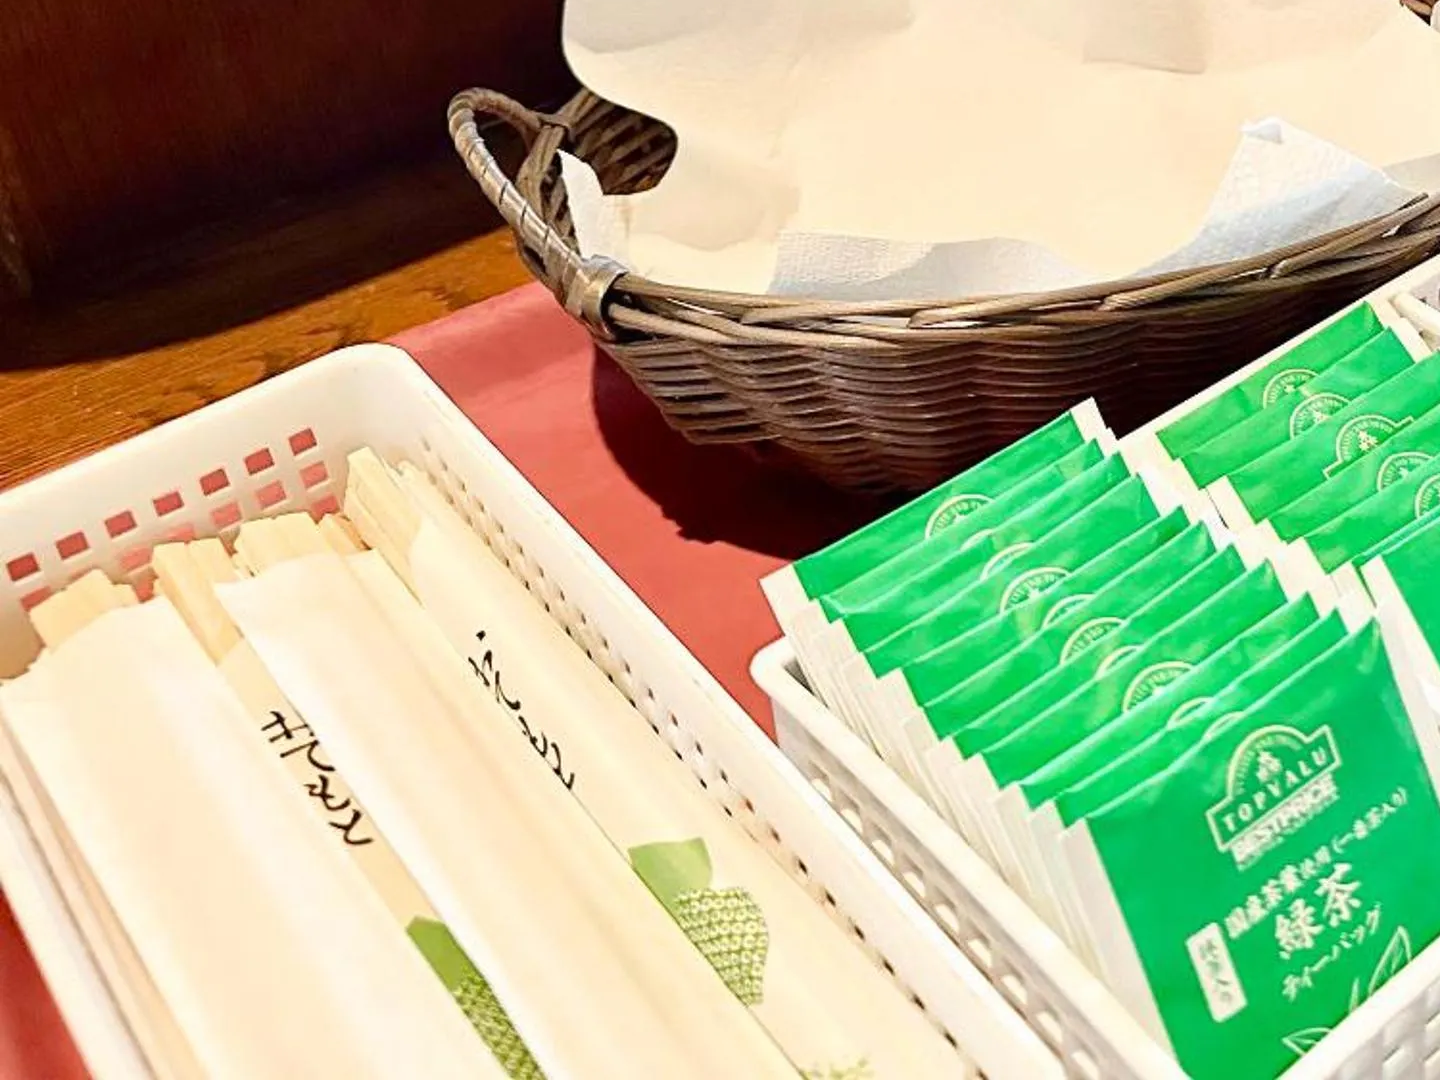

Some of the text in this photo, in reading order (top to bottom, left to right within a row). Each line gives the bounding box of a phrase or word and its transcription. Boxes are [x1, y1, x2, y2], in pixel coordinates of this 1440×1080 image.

[1222, 746, 1329, 834] TOPVALU
[1274, 862, 1362, 959] 緑茶
[1281, 902, 1382, 1002] ティーバッグ
